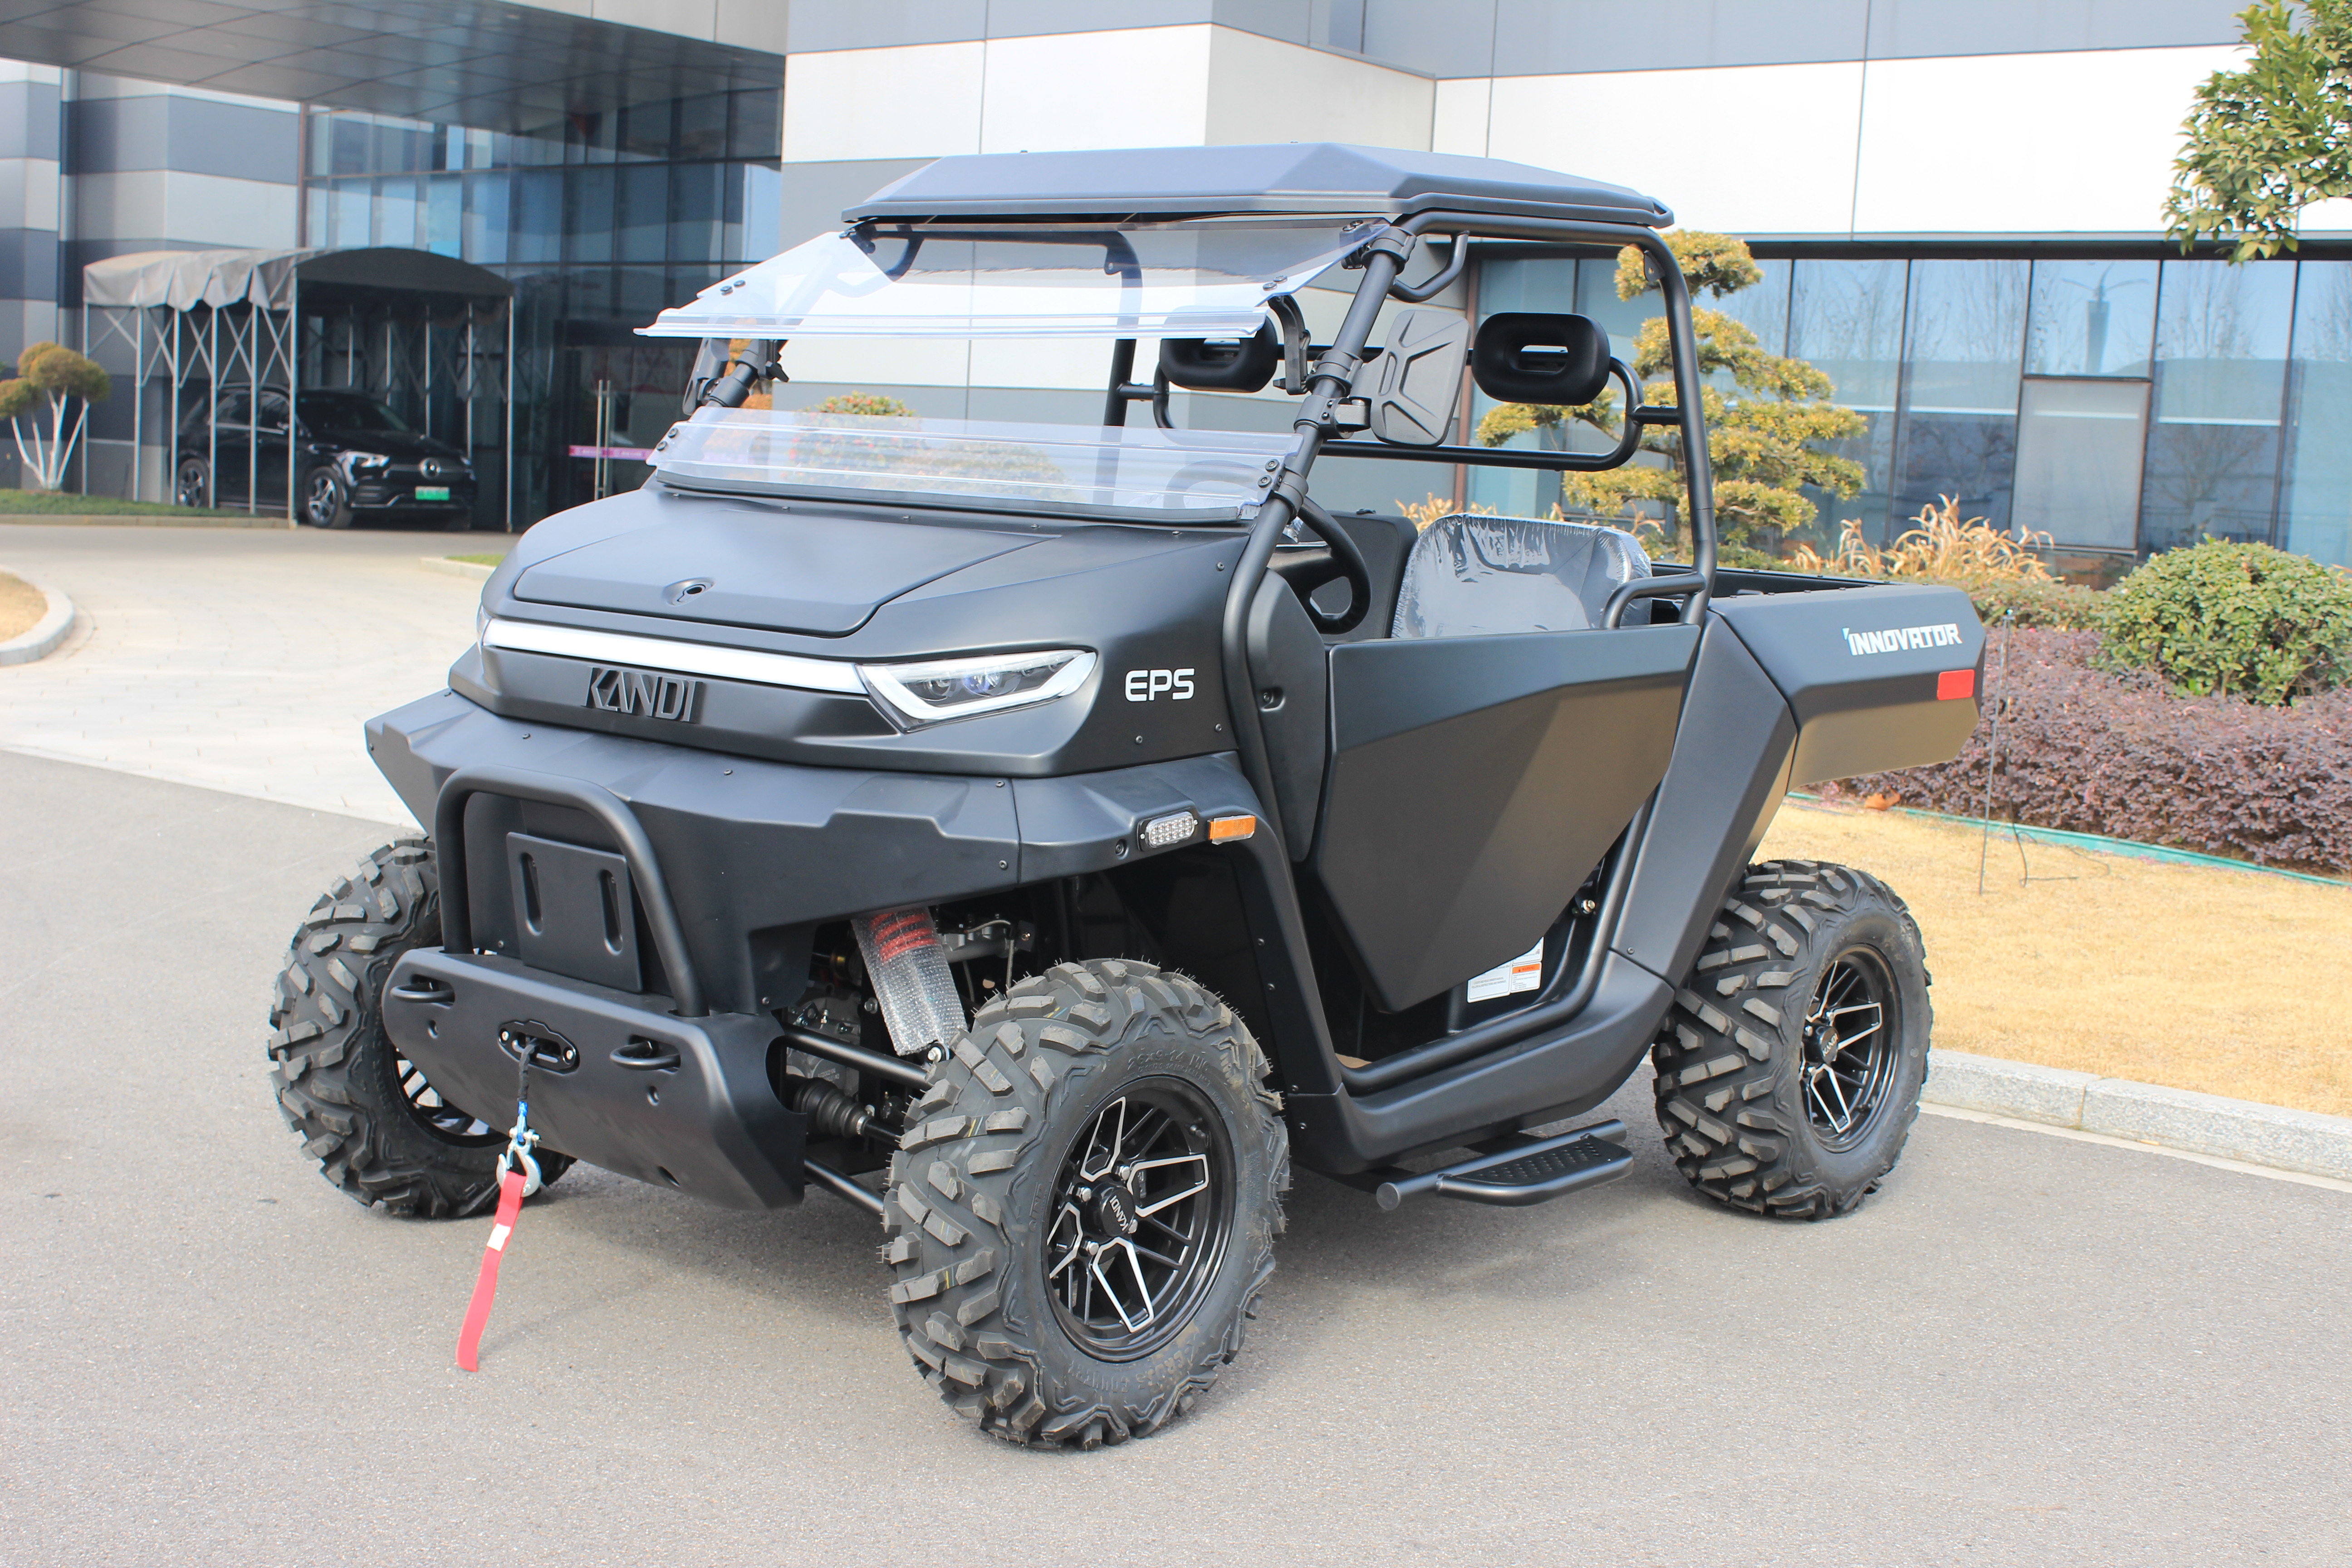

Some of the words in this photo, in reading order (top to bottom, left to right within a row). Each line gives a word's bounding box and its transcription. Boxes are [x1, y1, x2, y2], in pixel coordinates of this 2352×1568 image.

[1842, 623, 1963, 656] INNOVATOR
[583, 666, 700, 723] KANDI
[1125, 668, 1195, 702] EPS
[1823, 1033, 1838, 1057] KANDI
[1109, 1195, 1129, 1231] KANDI
